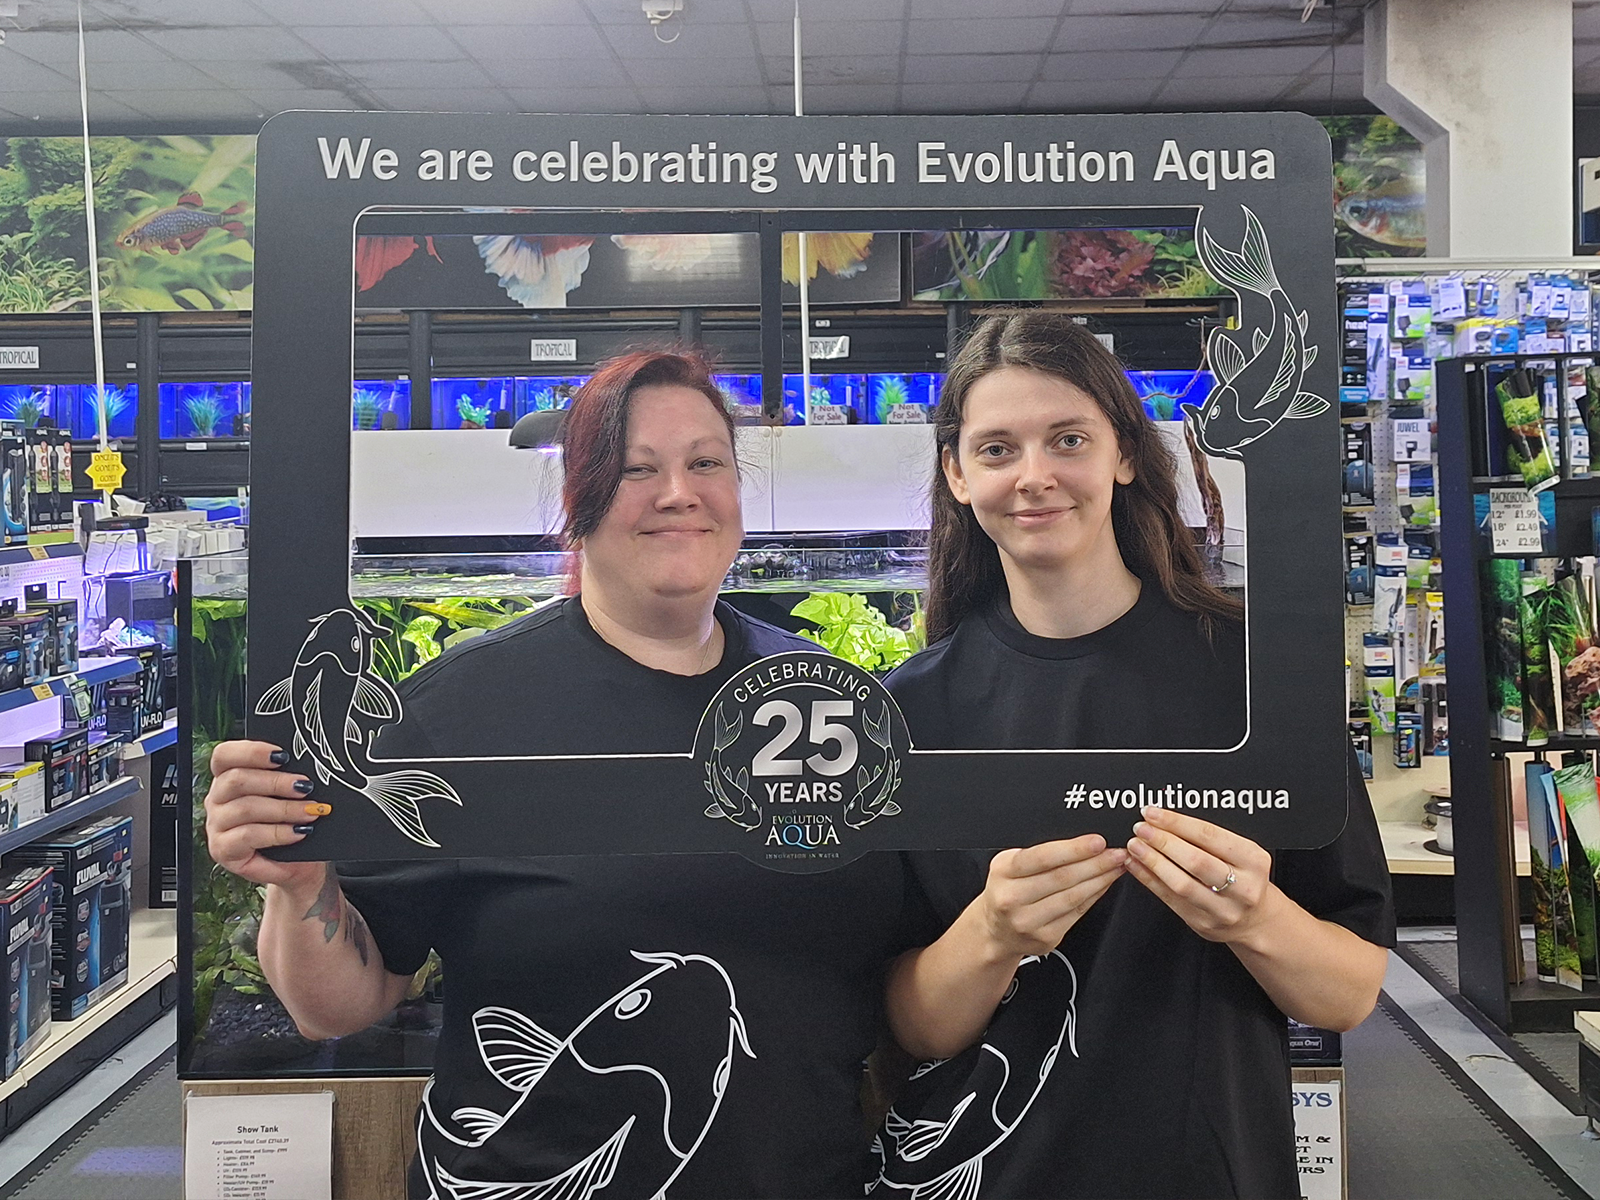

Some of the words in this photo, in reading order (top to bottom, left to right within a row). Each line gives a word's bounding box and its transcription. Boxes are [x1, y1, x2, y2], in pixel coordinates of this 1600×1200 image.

[317, 137, 398, 181] We
[417, 148, 494, 182] are
[511, 141, 778, 193] celebrating
[795, 141, 896, 184] with
[918, 141, 1135, 184] Evolution
[1152, 140, 1277, 190] Aqua
[535, 343, 573, 356] TROPICAL
[809, 340, 846, 354] TROPICL
[827, 412, 842, 420] Sale
[893, 411, 904, 419] For
[1396, 422, 1420, 432] JUWEL
[1515, 510, 1537, 518] £1.99
[1516, 523, 1538, 531] £2.49
[1518, 538, 1540, 546] £2.99
[733, 661, 871, 702] CELEBRATING
[141, 711, 163, 727] UV-FLO
[752, 700, 858, 777] 25
[764, 782, 843, 803] YEARS
[1064, 783, 1290, 815] #evolutionaqua
[772, 815, 833, 825] EVOLUTION
[764, 824, 841, 849] AQUA
[260, 1125, 279, 1133] Tank
[1315, 1156, 1334, 1164] IN
